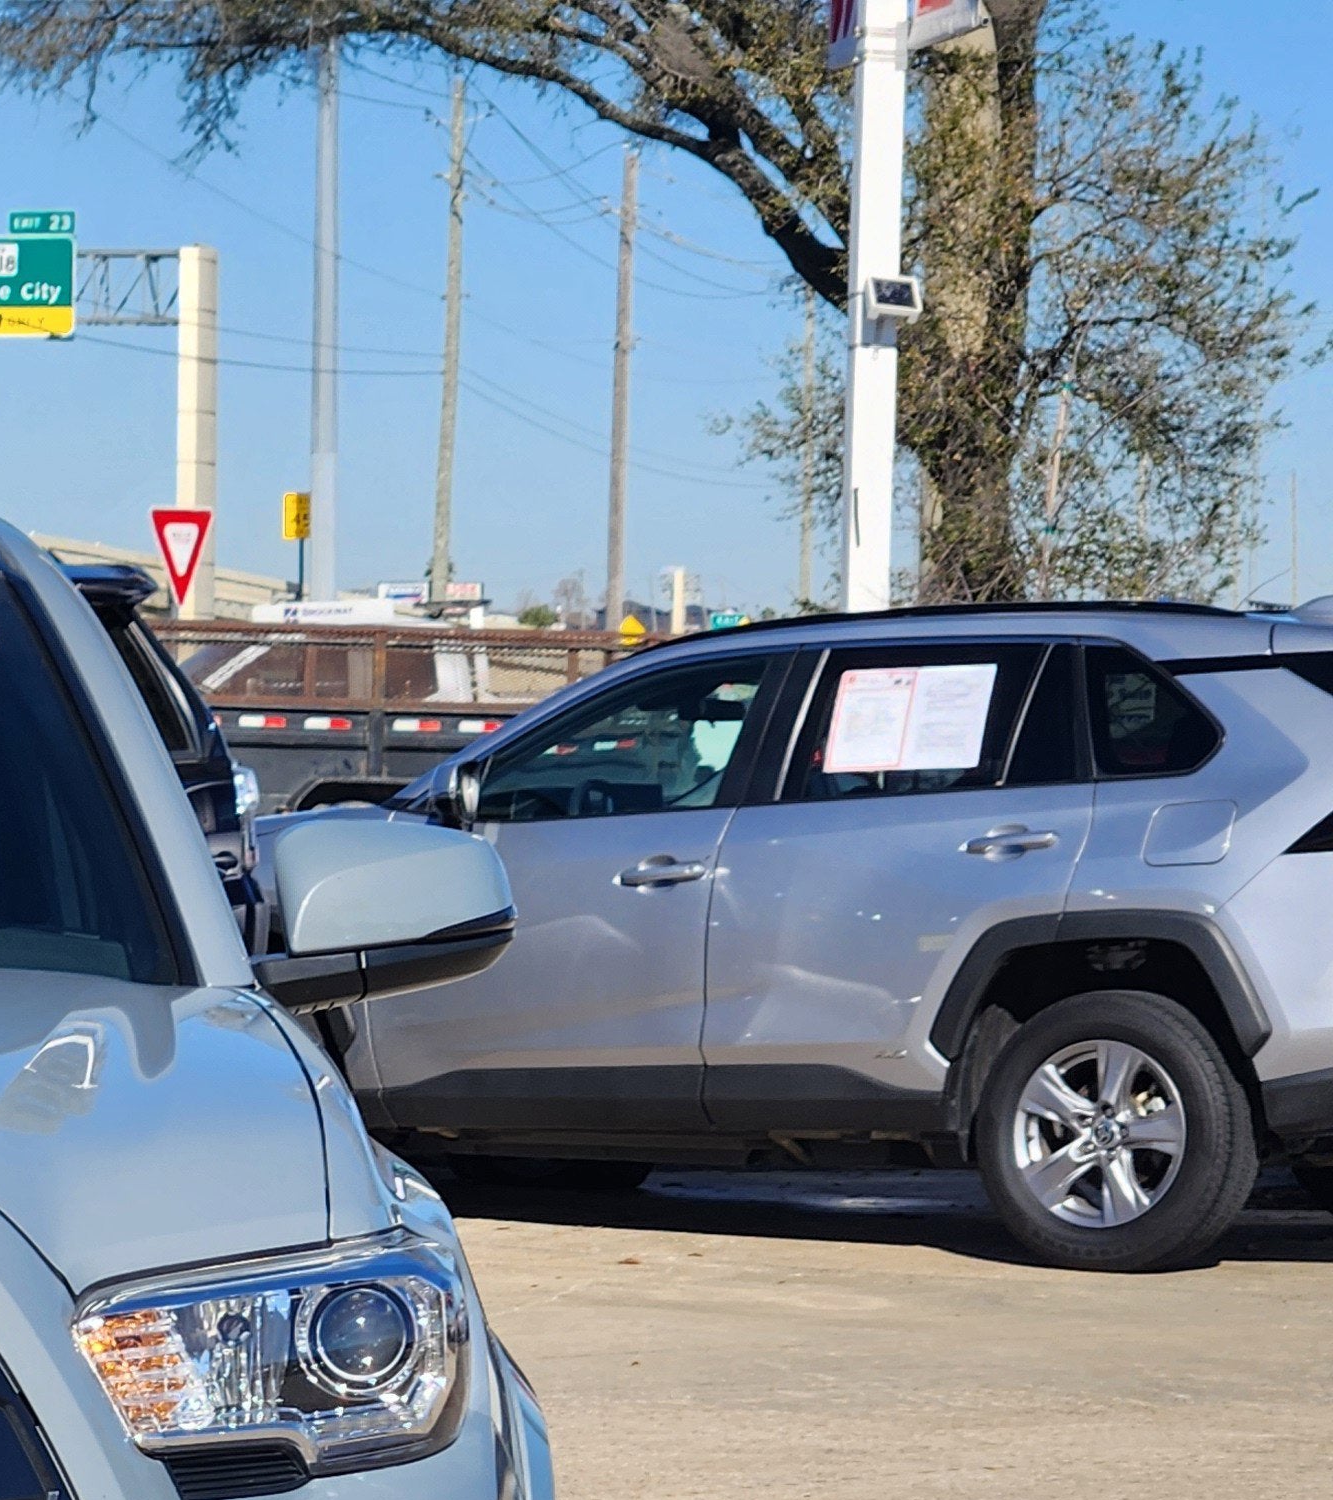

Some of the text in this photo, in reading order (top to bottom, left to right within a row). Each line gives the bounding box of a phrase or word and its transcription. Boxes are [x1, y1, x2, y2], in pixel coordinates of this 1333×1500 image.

[13, 214, 71, 231] EXIT 23
[20, 282, 62, 305] City
